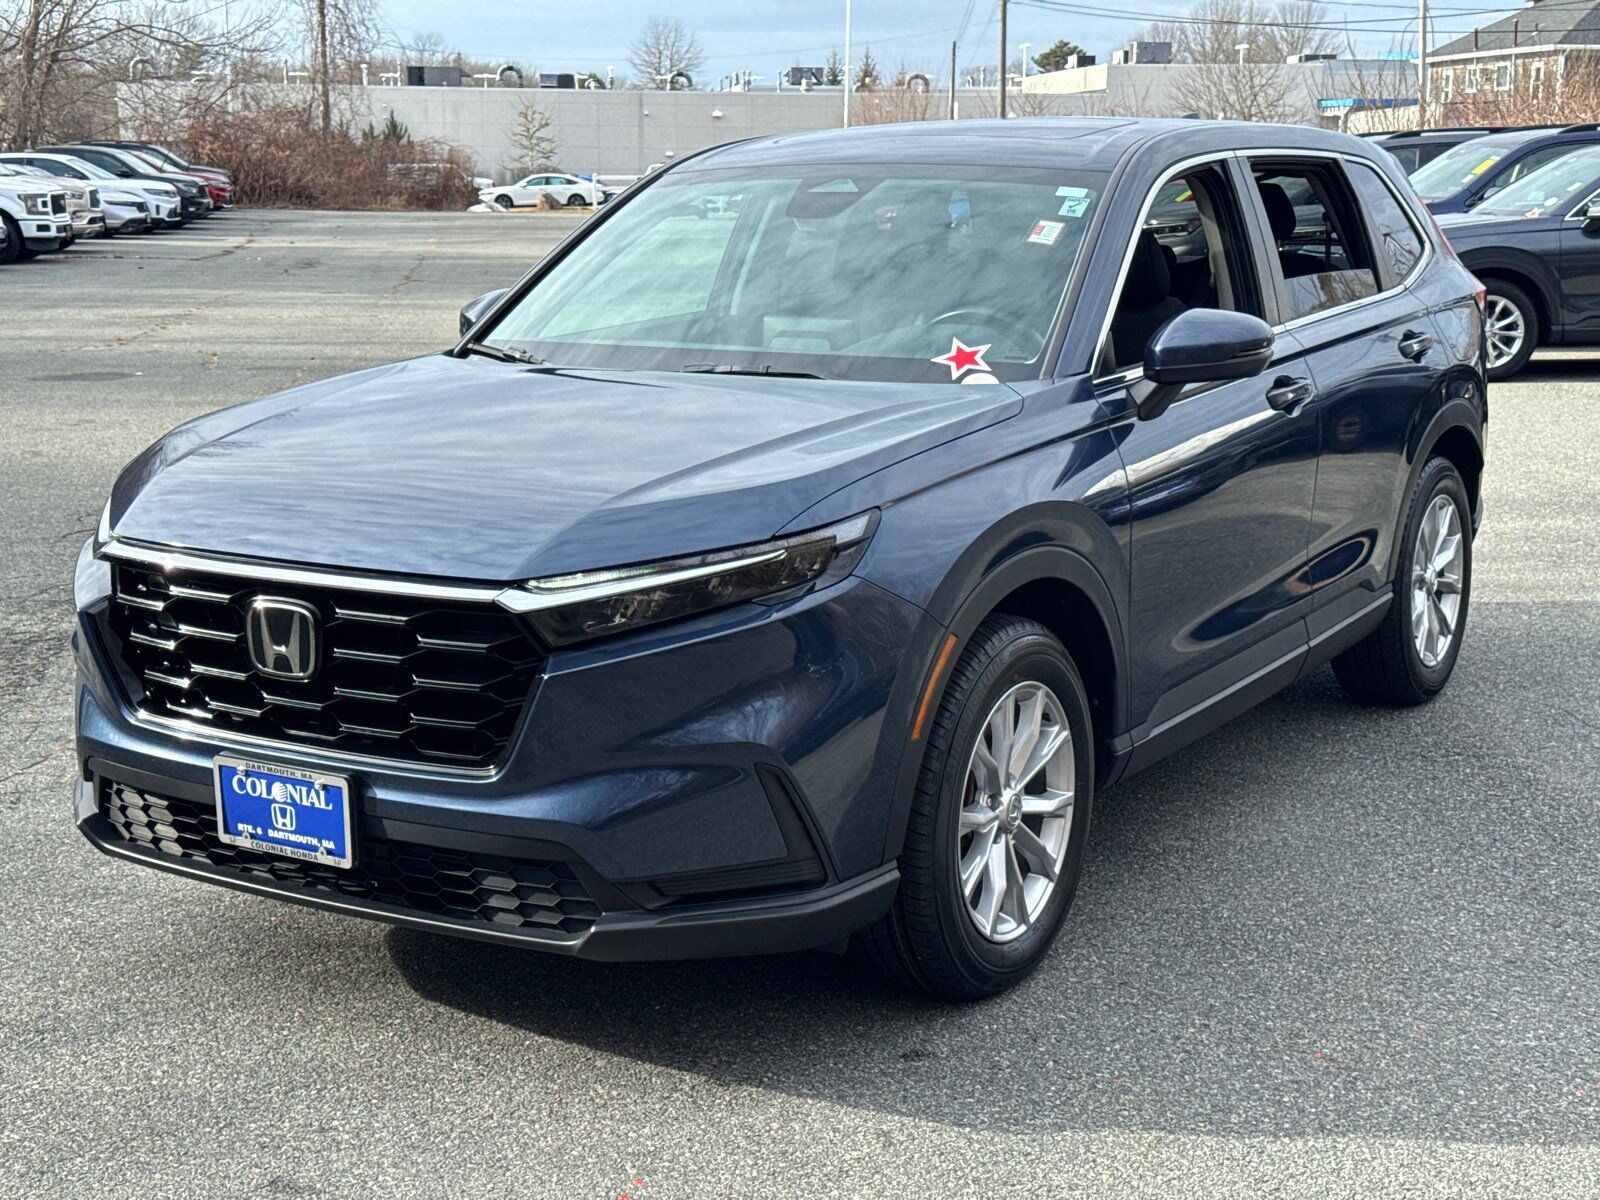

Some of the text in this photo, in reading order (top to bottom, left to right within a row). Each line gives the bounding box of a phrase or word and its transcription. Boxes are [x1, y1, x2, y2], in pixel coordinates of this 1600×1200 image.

[300, 771, 313, 780] MA
[232, 775, 333, 810] COLONIAL
[251, 841, 319, 861] COLONIAL HONDA
[322, 839, 335, 849] MA
